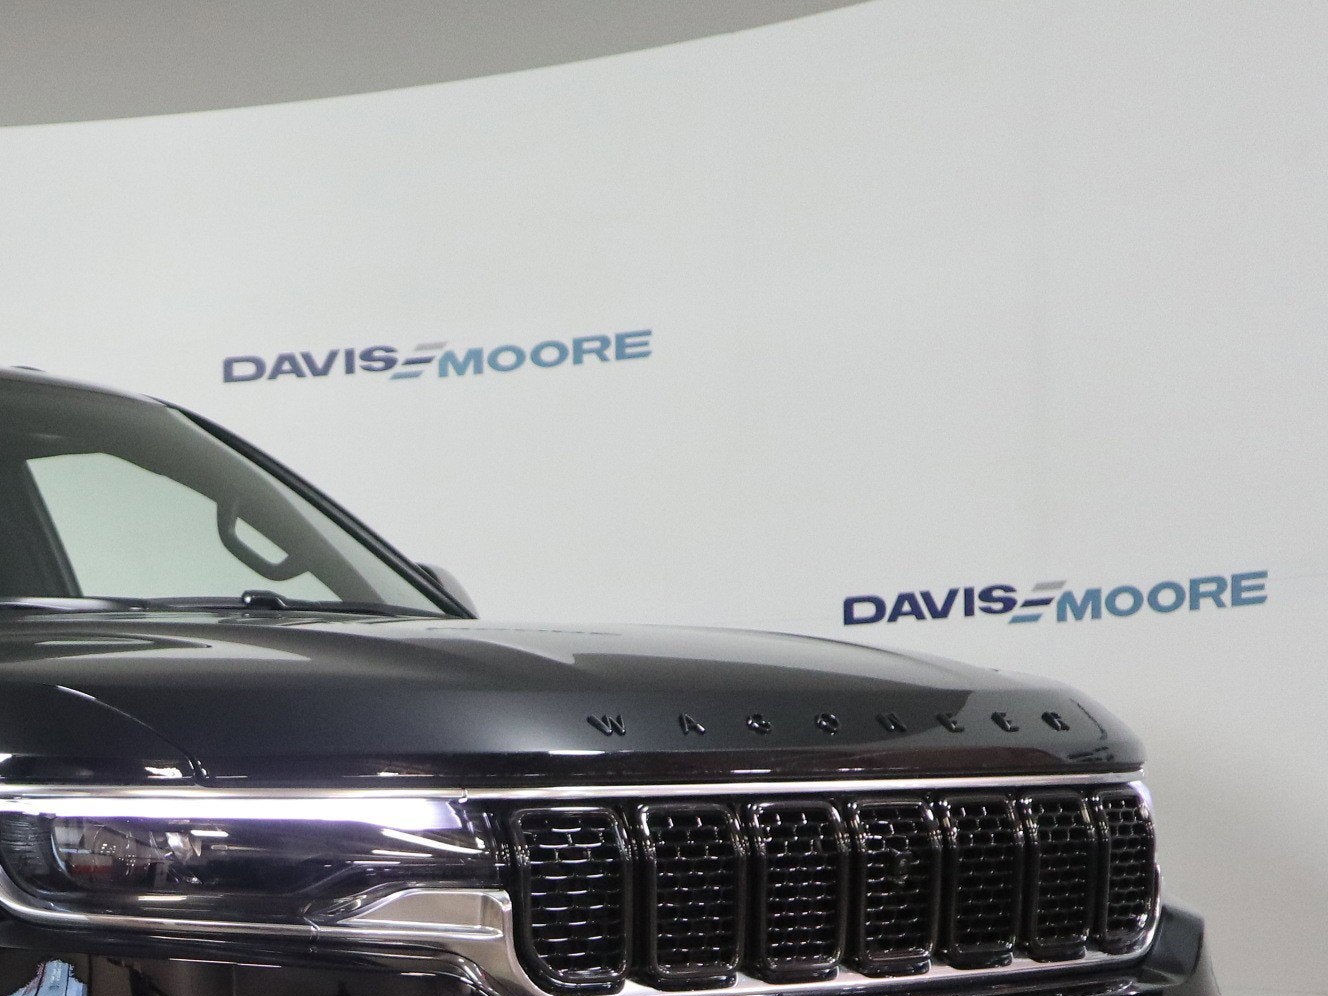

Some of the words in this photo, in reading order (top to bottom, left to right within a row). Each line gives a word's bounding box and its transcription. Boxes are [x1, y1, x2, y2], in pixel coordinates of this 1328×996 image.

[222, 344, 399, 383] DAVIS
[437, 329, 653, 378] MOORE
[843, 584, 1018, 625] DAVIS
[1056, 570, 1269, 622] MOORE
[586, 711, 1071, 736] WAGONEER
